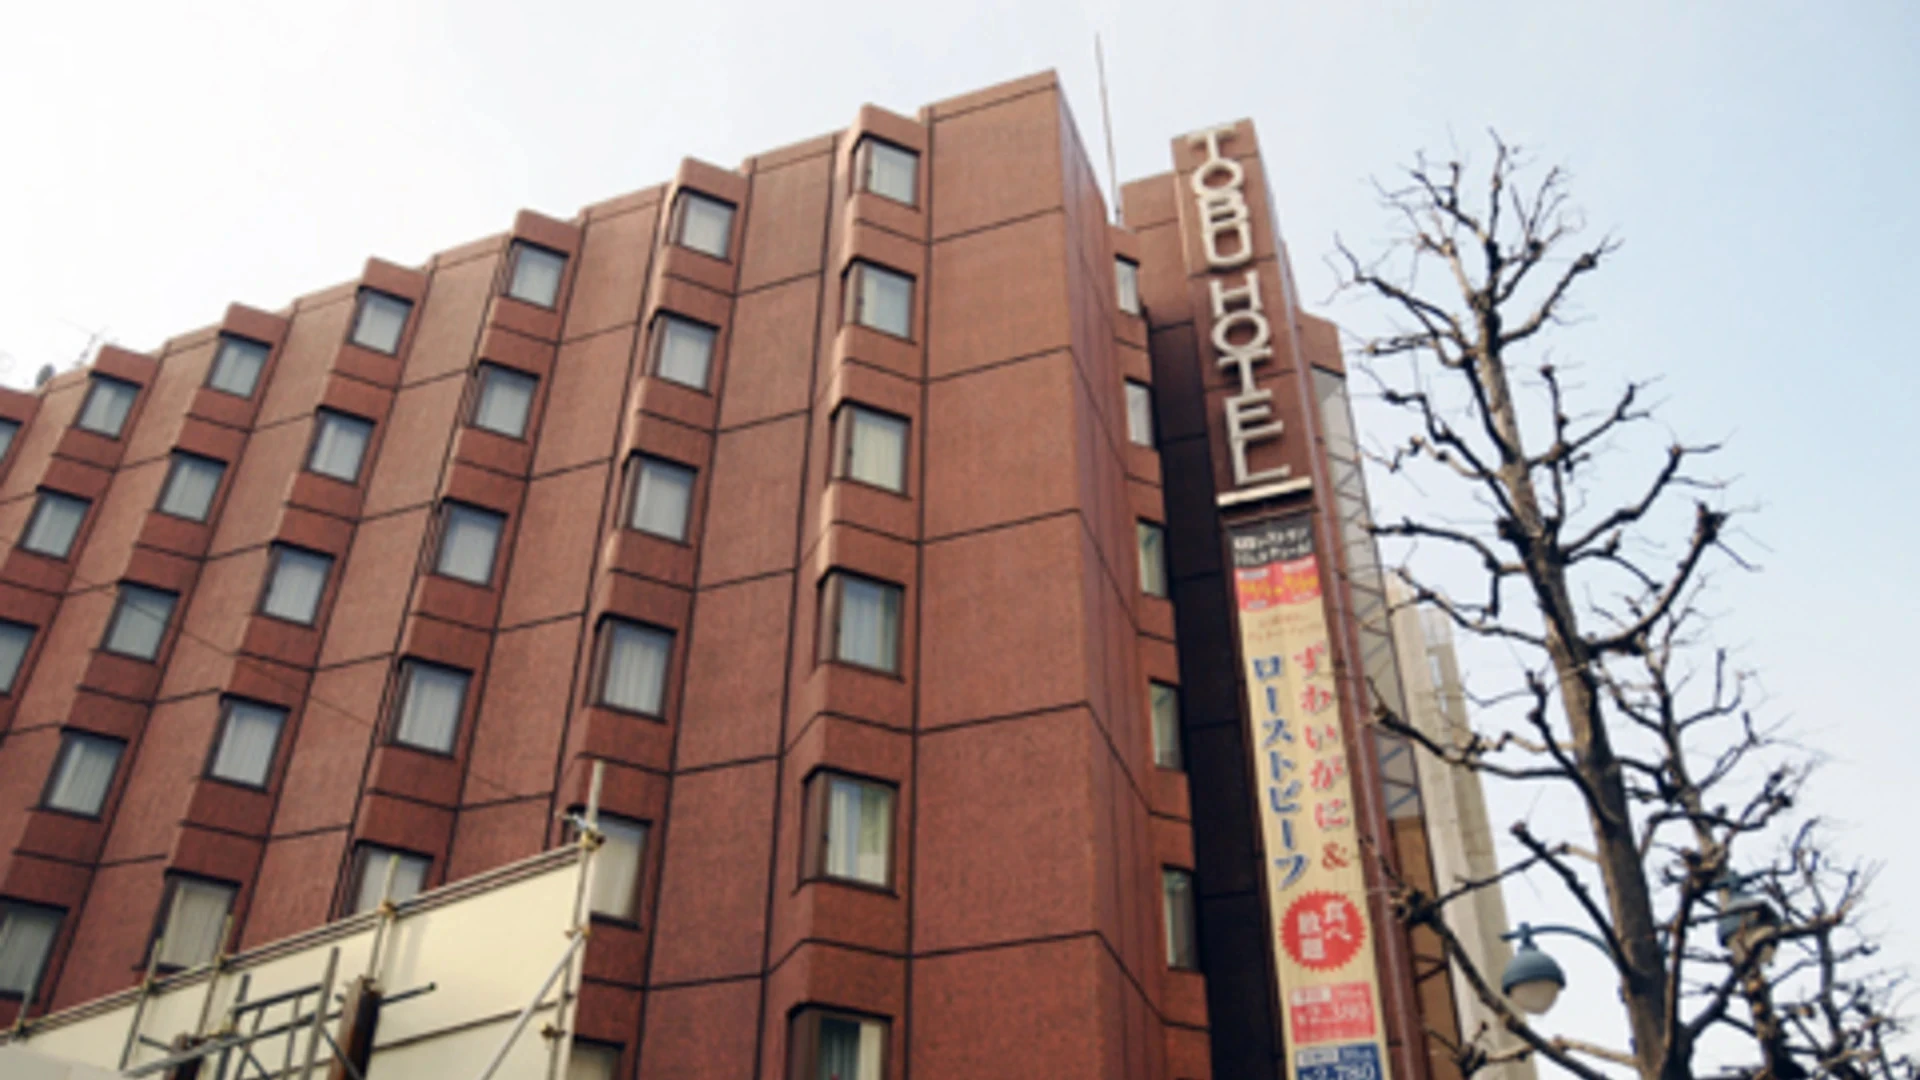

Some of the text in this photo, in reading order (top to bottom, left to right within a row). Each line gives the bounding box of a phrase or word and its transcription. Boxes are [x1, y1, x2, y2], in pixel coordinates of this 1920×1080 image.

[1187, 124, 1253, 269] TOBU
[1210, 270, 1291, 486] HOTEL
[1252, 655, 1309, 888] ローストビーフ
[1294, 641, 1348, 829] ずわいがに
[1322, 842, 1350, 870] &
